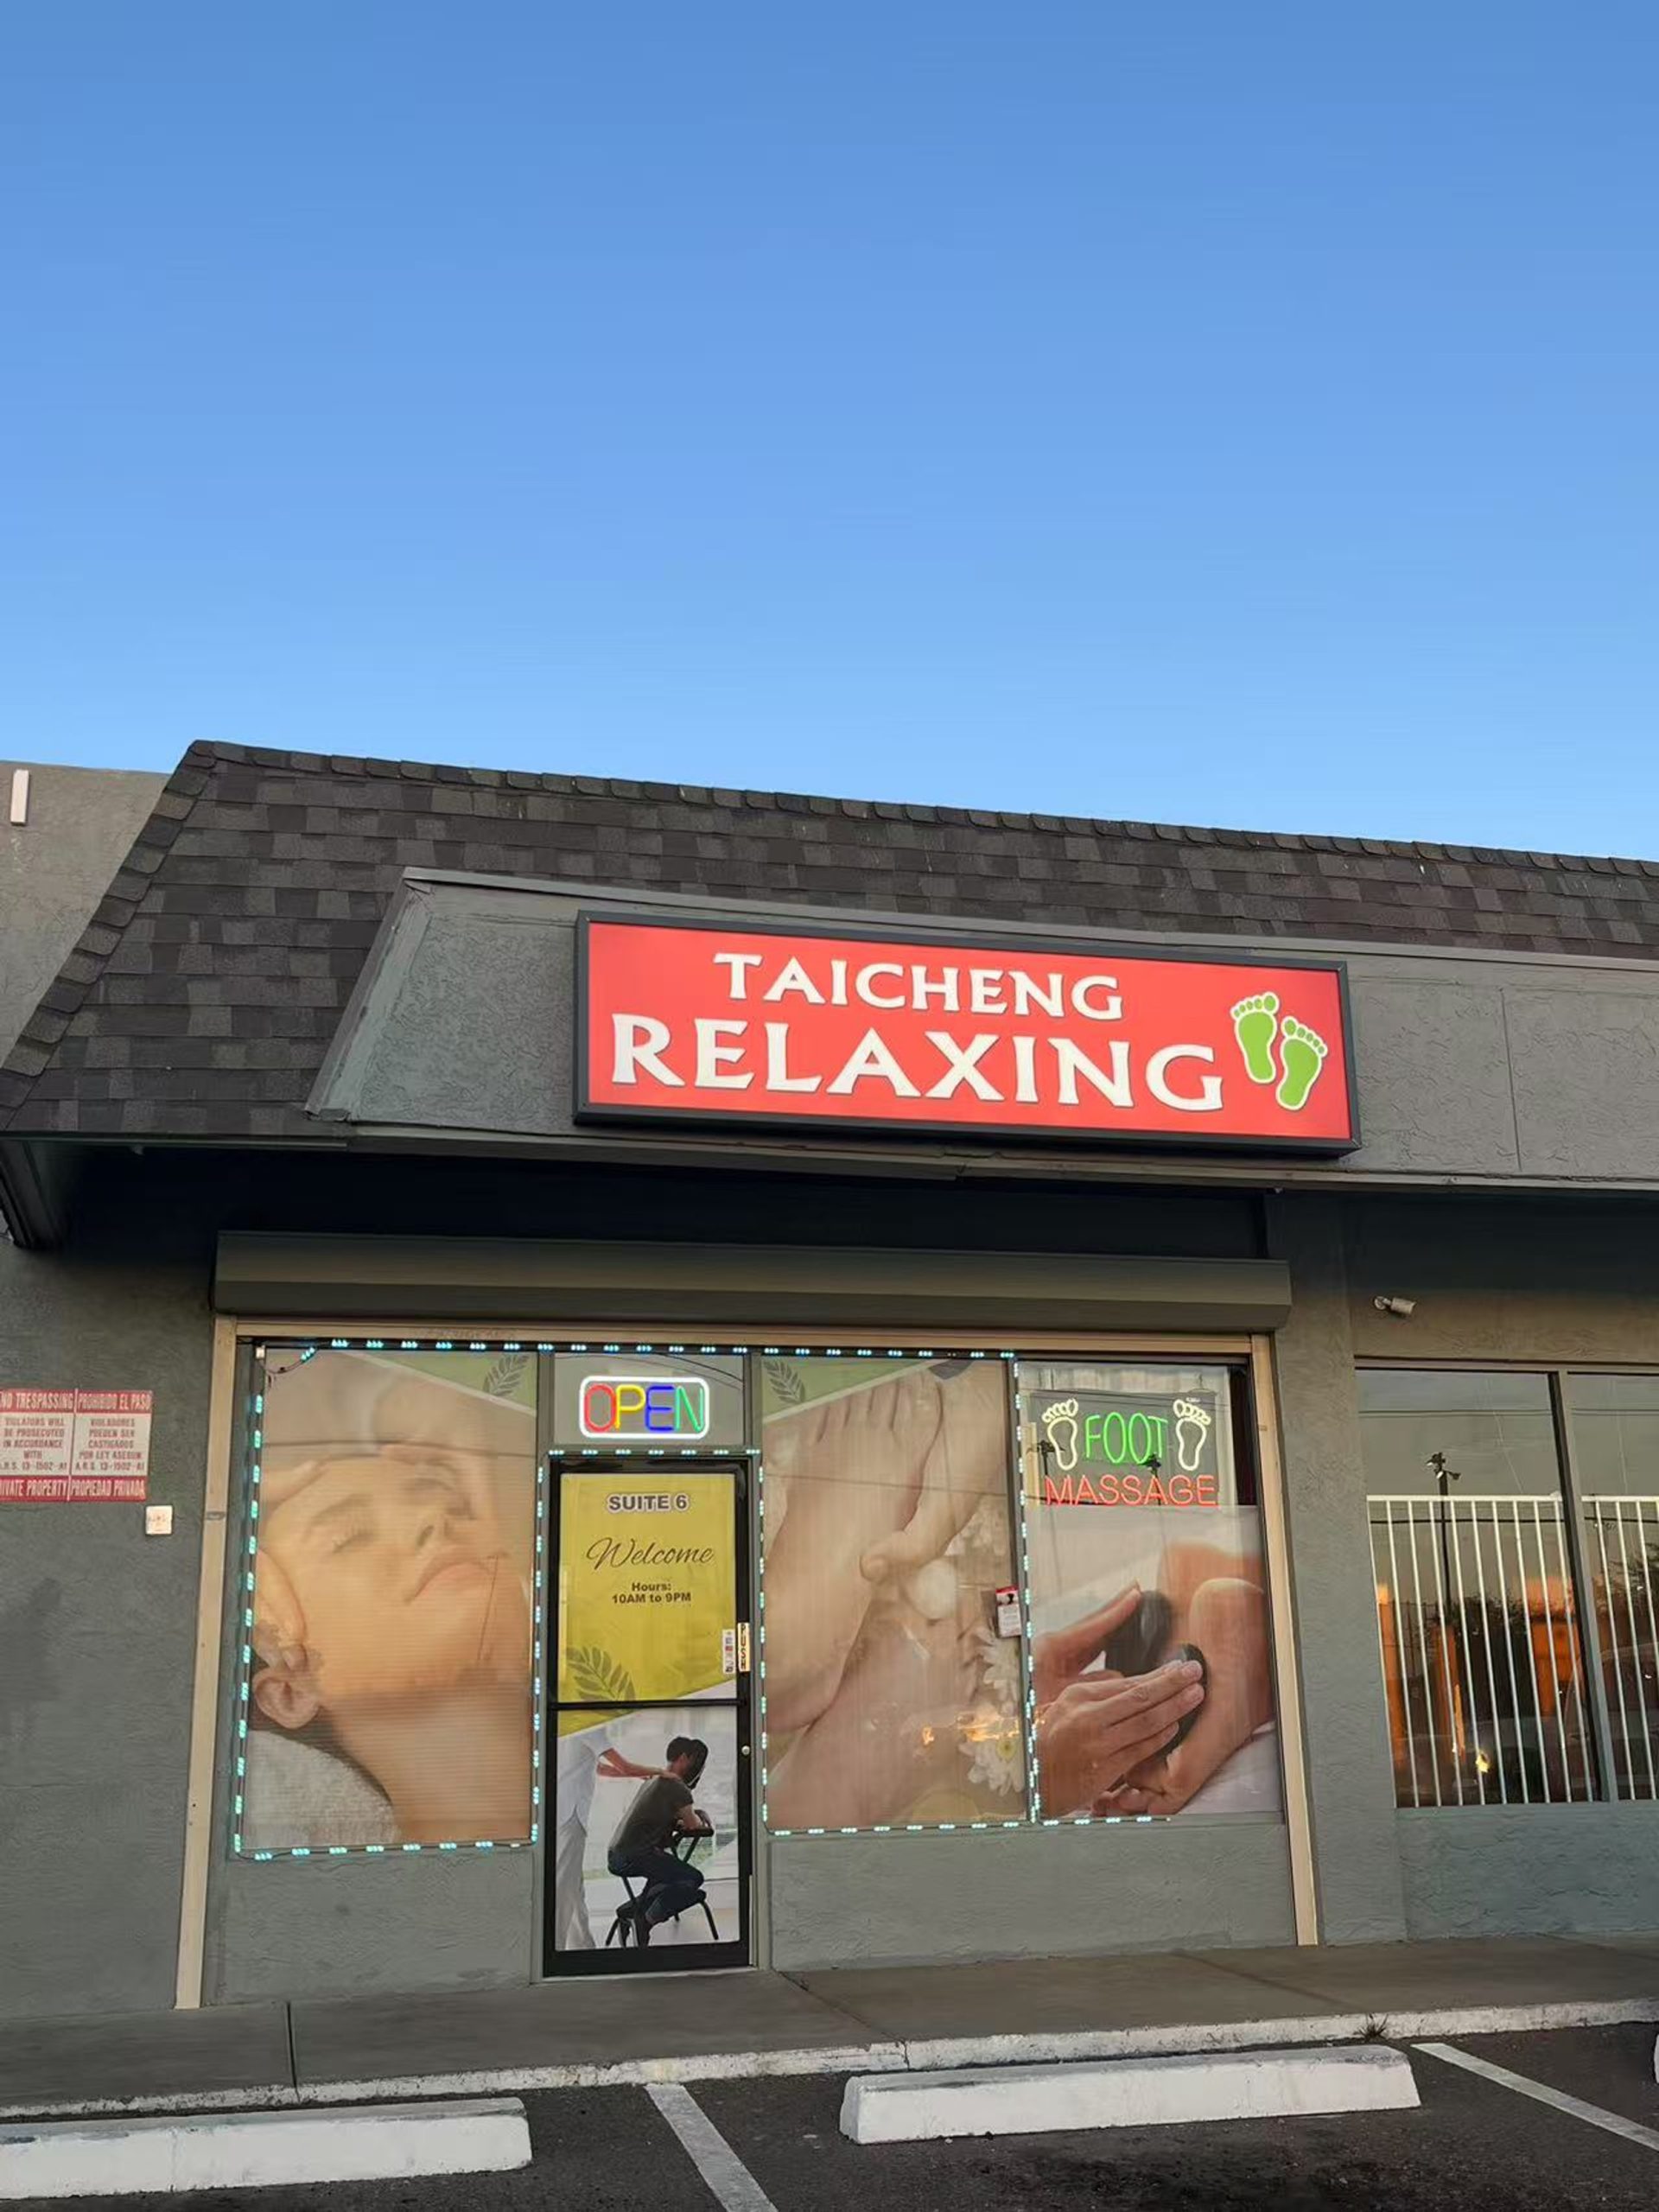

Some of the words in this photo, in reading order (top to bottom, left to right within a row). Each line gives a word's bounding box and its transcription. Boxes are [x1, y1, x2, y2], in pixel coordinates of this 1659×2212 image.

[714, 952, 1124, 1021] TAICHENG
[611, 1014, 1224, 1112] RELAXING
[16, 1392, 73, 1410] TRESPASSING
[119, 1393, 130, 1410] EL
[130, 1393, 151, 1410] PASO
[584, 1383, 705, 1433] OPEN
[4, 1428, 13, 1437] BE
[16, 1428, 65, 1437] PROSECUTED
[1084, 1412, 1168, 1464] FOOT
[14, 1440, 62, 1448] ACCORDANCE
[23, 1451, 42, 1459] WITH
[26, 1479, 67, 1497] PROPERTY
[71, 1479, 112, 1497] PROPIEDAD
[113, 1479, 146, 1497] PRIVADA
[1045, 1474, 1217, 1506] MASSAGE
[608, 1495, 670, 1511] SUITE
[676, 1495, 689, 1510] 6
[586, 1537, 715, 1571] Welcome
[632, 1583, 671, 1592] Hours:
[612, 1594, 646, 1604] 10AM
[650, 1594, 662, 1603] to
[665, 1593, 691, 1603] 9PM
